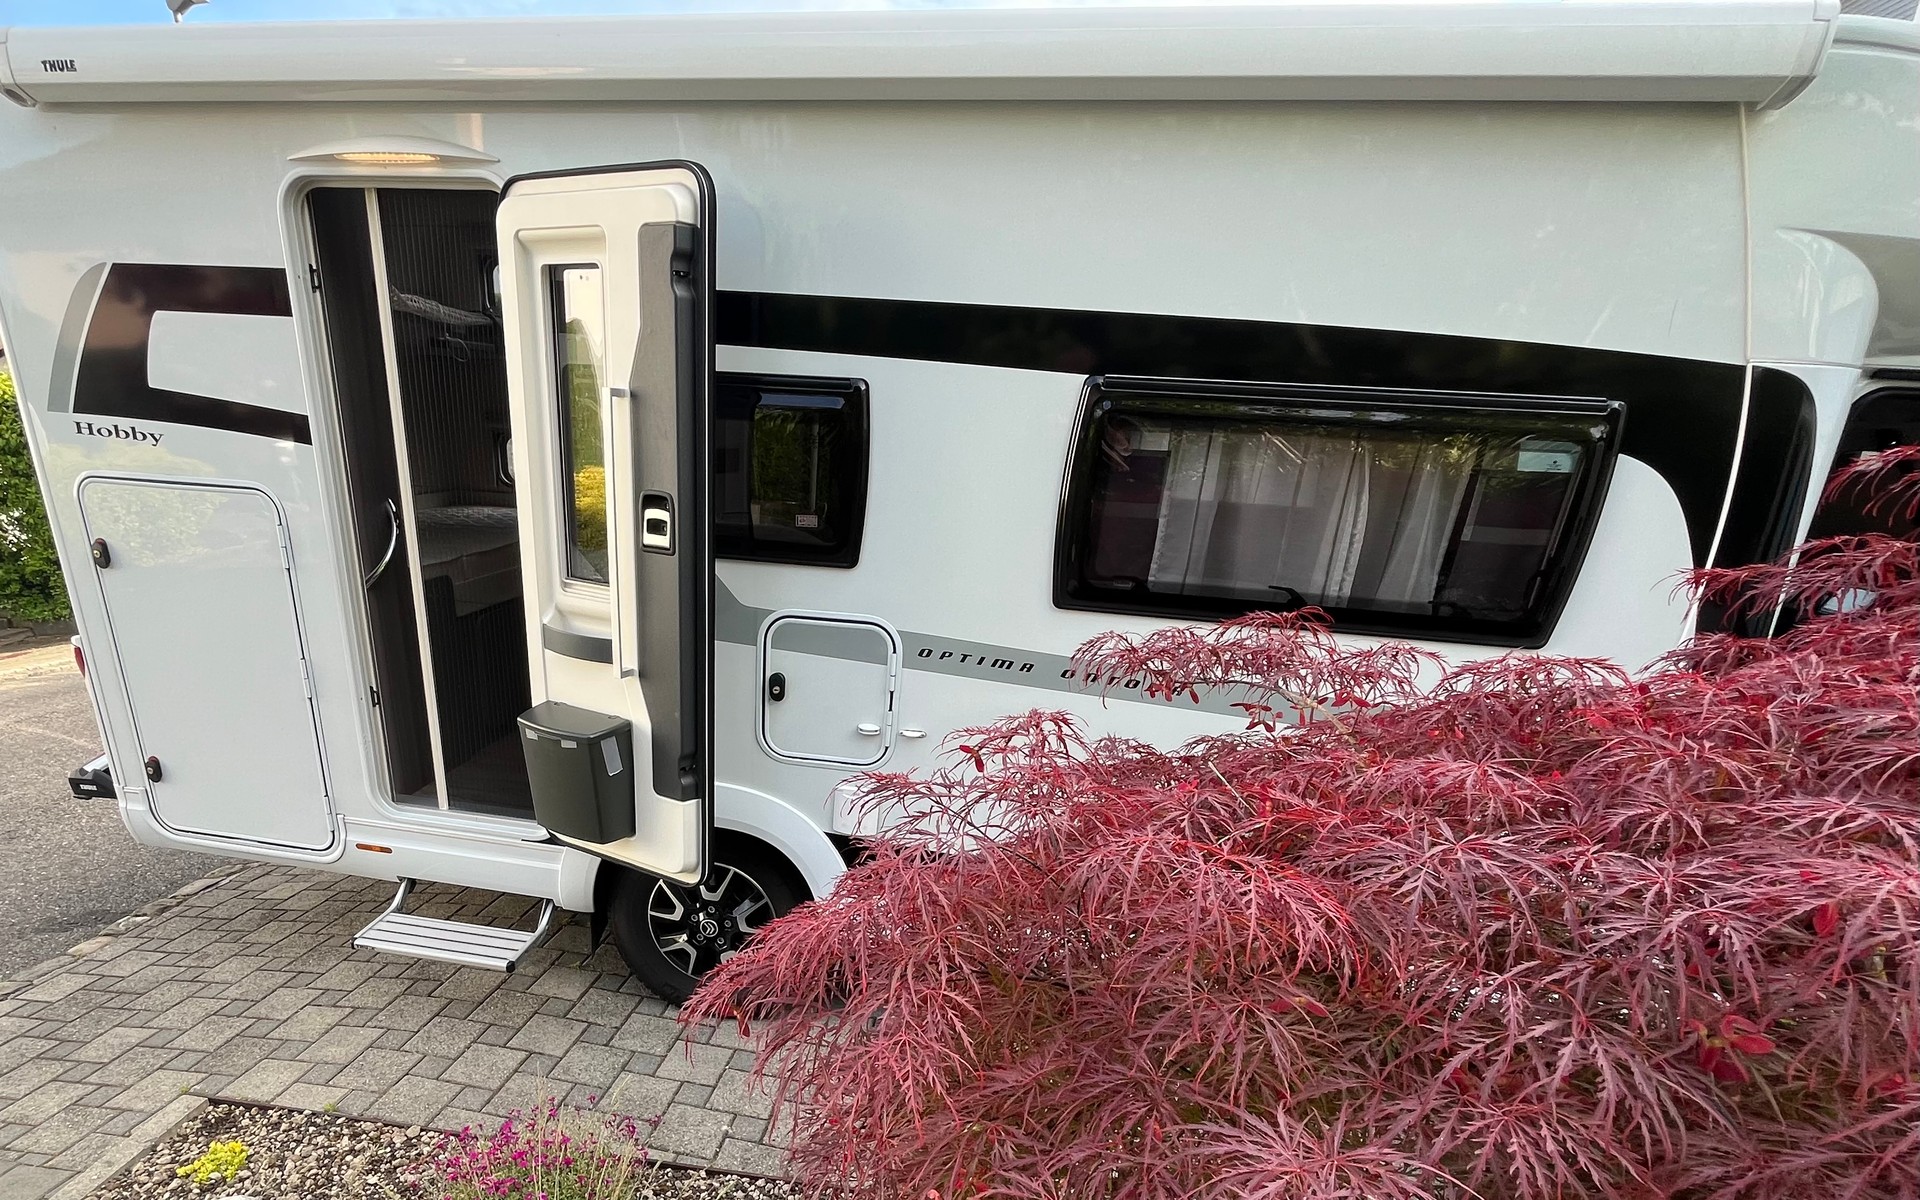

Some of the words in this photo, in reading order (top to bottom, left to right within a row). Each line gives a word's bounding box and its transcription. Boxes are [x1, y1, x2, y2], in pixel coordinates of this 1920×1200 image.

[40, 59, 77, 73] THULE
[73, 421, 164, 447] Hobby
[917, 648, 1035, 673] OPTIMA
